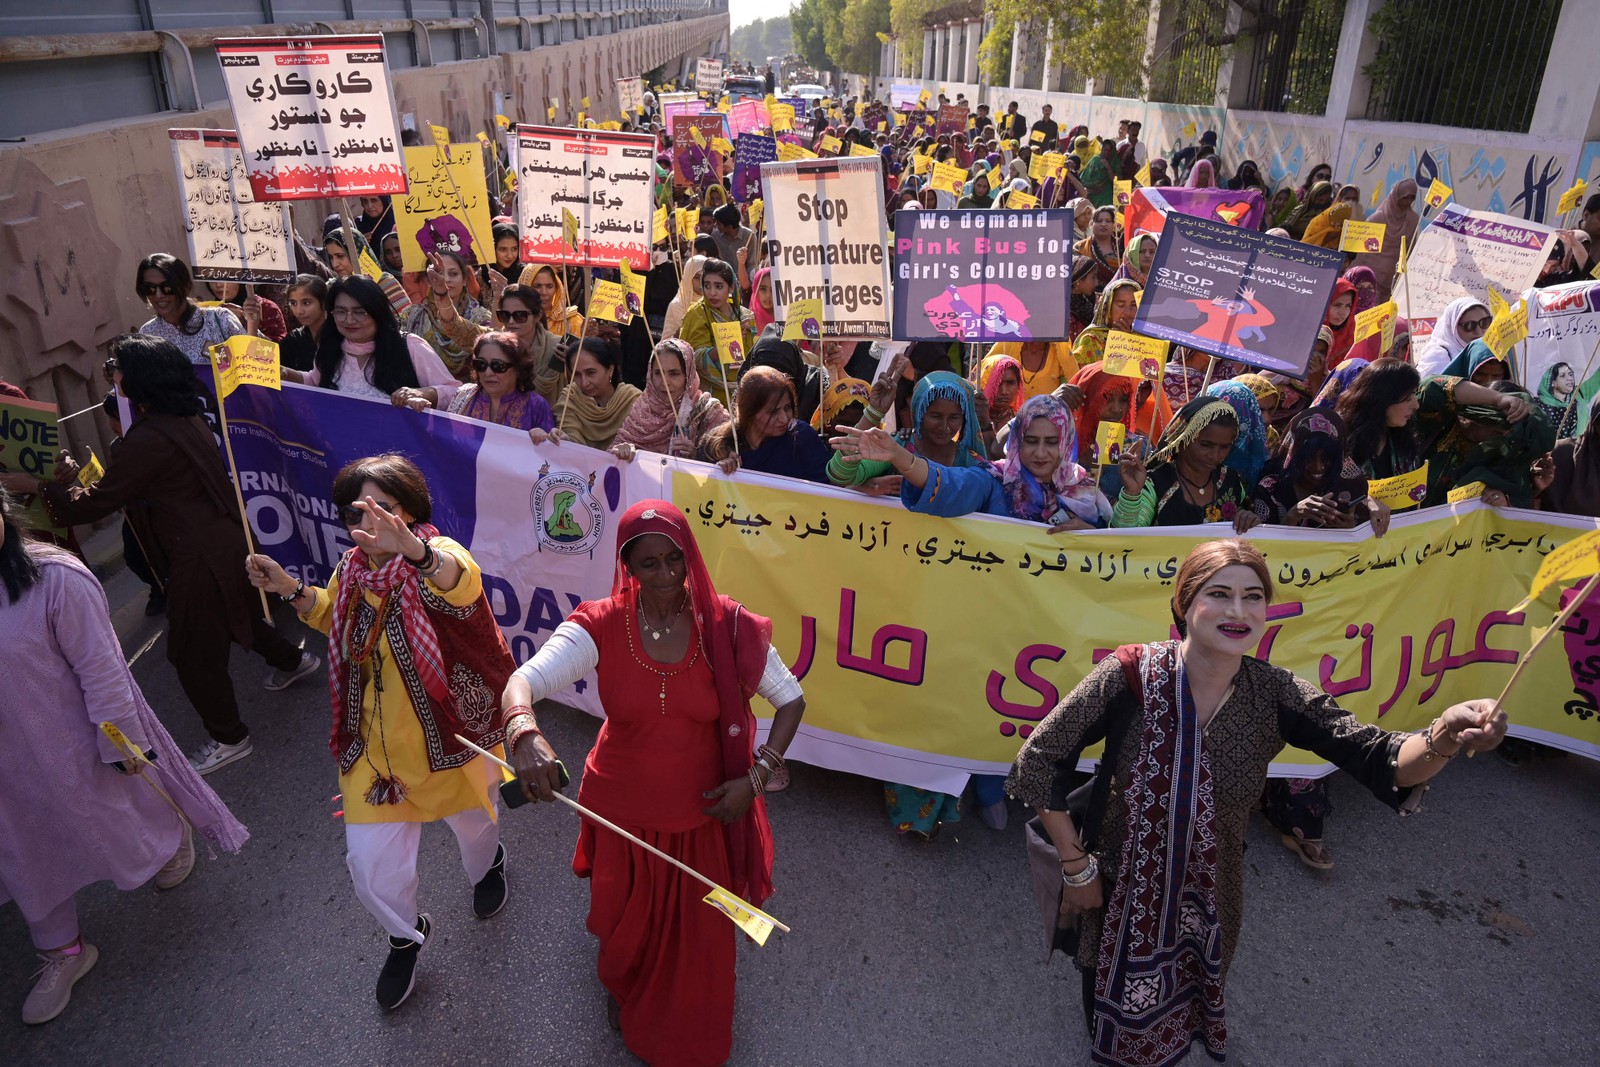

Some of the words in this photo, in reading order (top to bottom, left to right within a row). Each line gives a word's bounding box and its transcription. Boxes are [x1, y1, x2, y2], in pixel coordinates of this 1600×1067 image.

[708, 63, 720, 72] More
[268, 106, 332, 131] دستور
[340, 108, 366, 130] جو
[254, 139, 318, 161] نامنظور
[332, 137, 394, 158] نامنظور
[608, 167, 650, 186] جنسي
[797, 192, 848, 228] Stop
[920, 212, 950, 230] We
[960, 211, 1048, 229] demand
[592, 218, 644, 234] نامنظور
[768, 238, 883, 266] Premature
[897, 238, 960, 255] Pink
[974, 237, 1028, 254] Bus
[1038, 237, 1070, 254] for
[899, 262, 960, 280] Girl's
[970, 262, 1070, 280] Colleges
[1157, 267, 1214, 288] STOP
[775, 278, 883, 313] Marriages
[1153, 281, 1182, 294] AGAINST
[1182, 288, 1210, 300] WOMEN
[1155, 276, 1211, 296] VIOLENCE
[1288, 282, 1314, 296] عورت
[923, 310, 972, 320] عورت
[844, 322, 864, 334] Awami
[866, 322, 890, 334] Tahreek
[227, 425, 248, 435] The
[19, 446, 54, 475] OF
[535, 486, 544, 532] UNIVERSITY
[590, 502, 600, 512] OF
[593, 514, 602, 538] SINDH
[784, 511, 830, 540] فرد
[842, 520, 892, 552] آزاد
[1018, 546, 1068, 578] فرد
[1079, 549, 1133, 583] آزاد
[789, 587, 928, 687] مار
[1318, 610, 1526, 719] عورت
